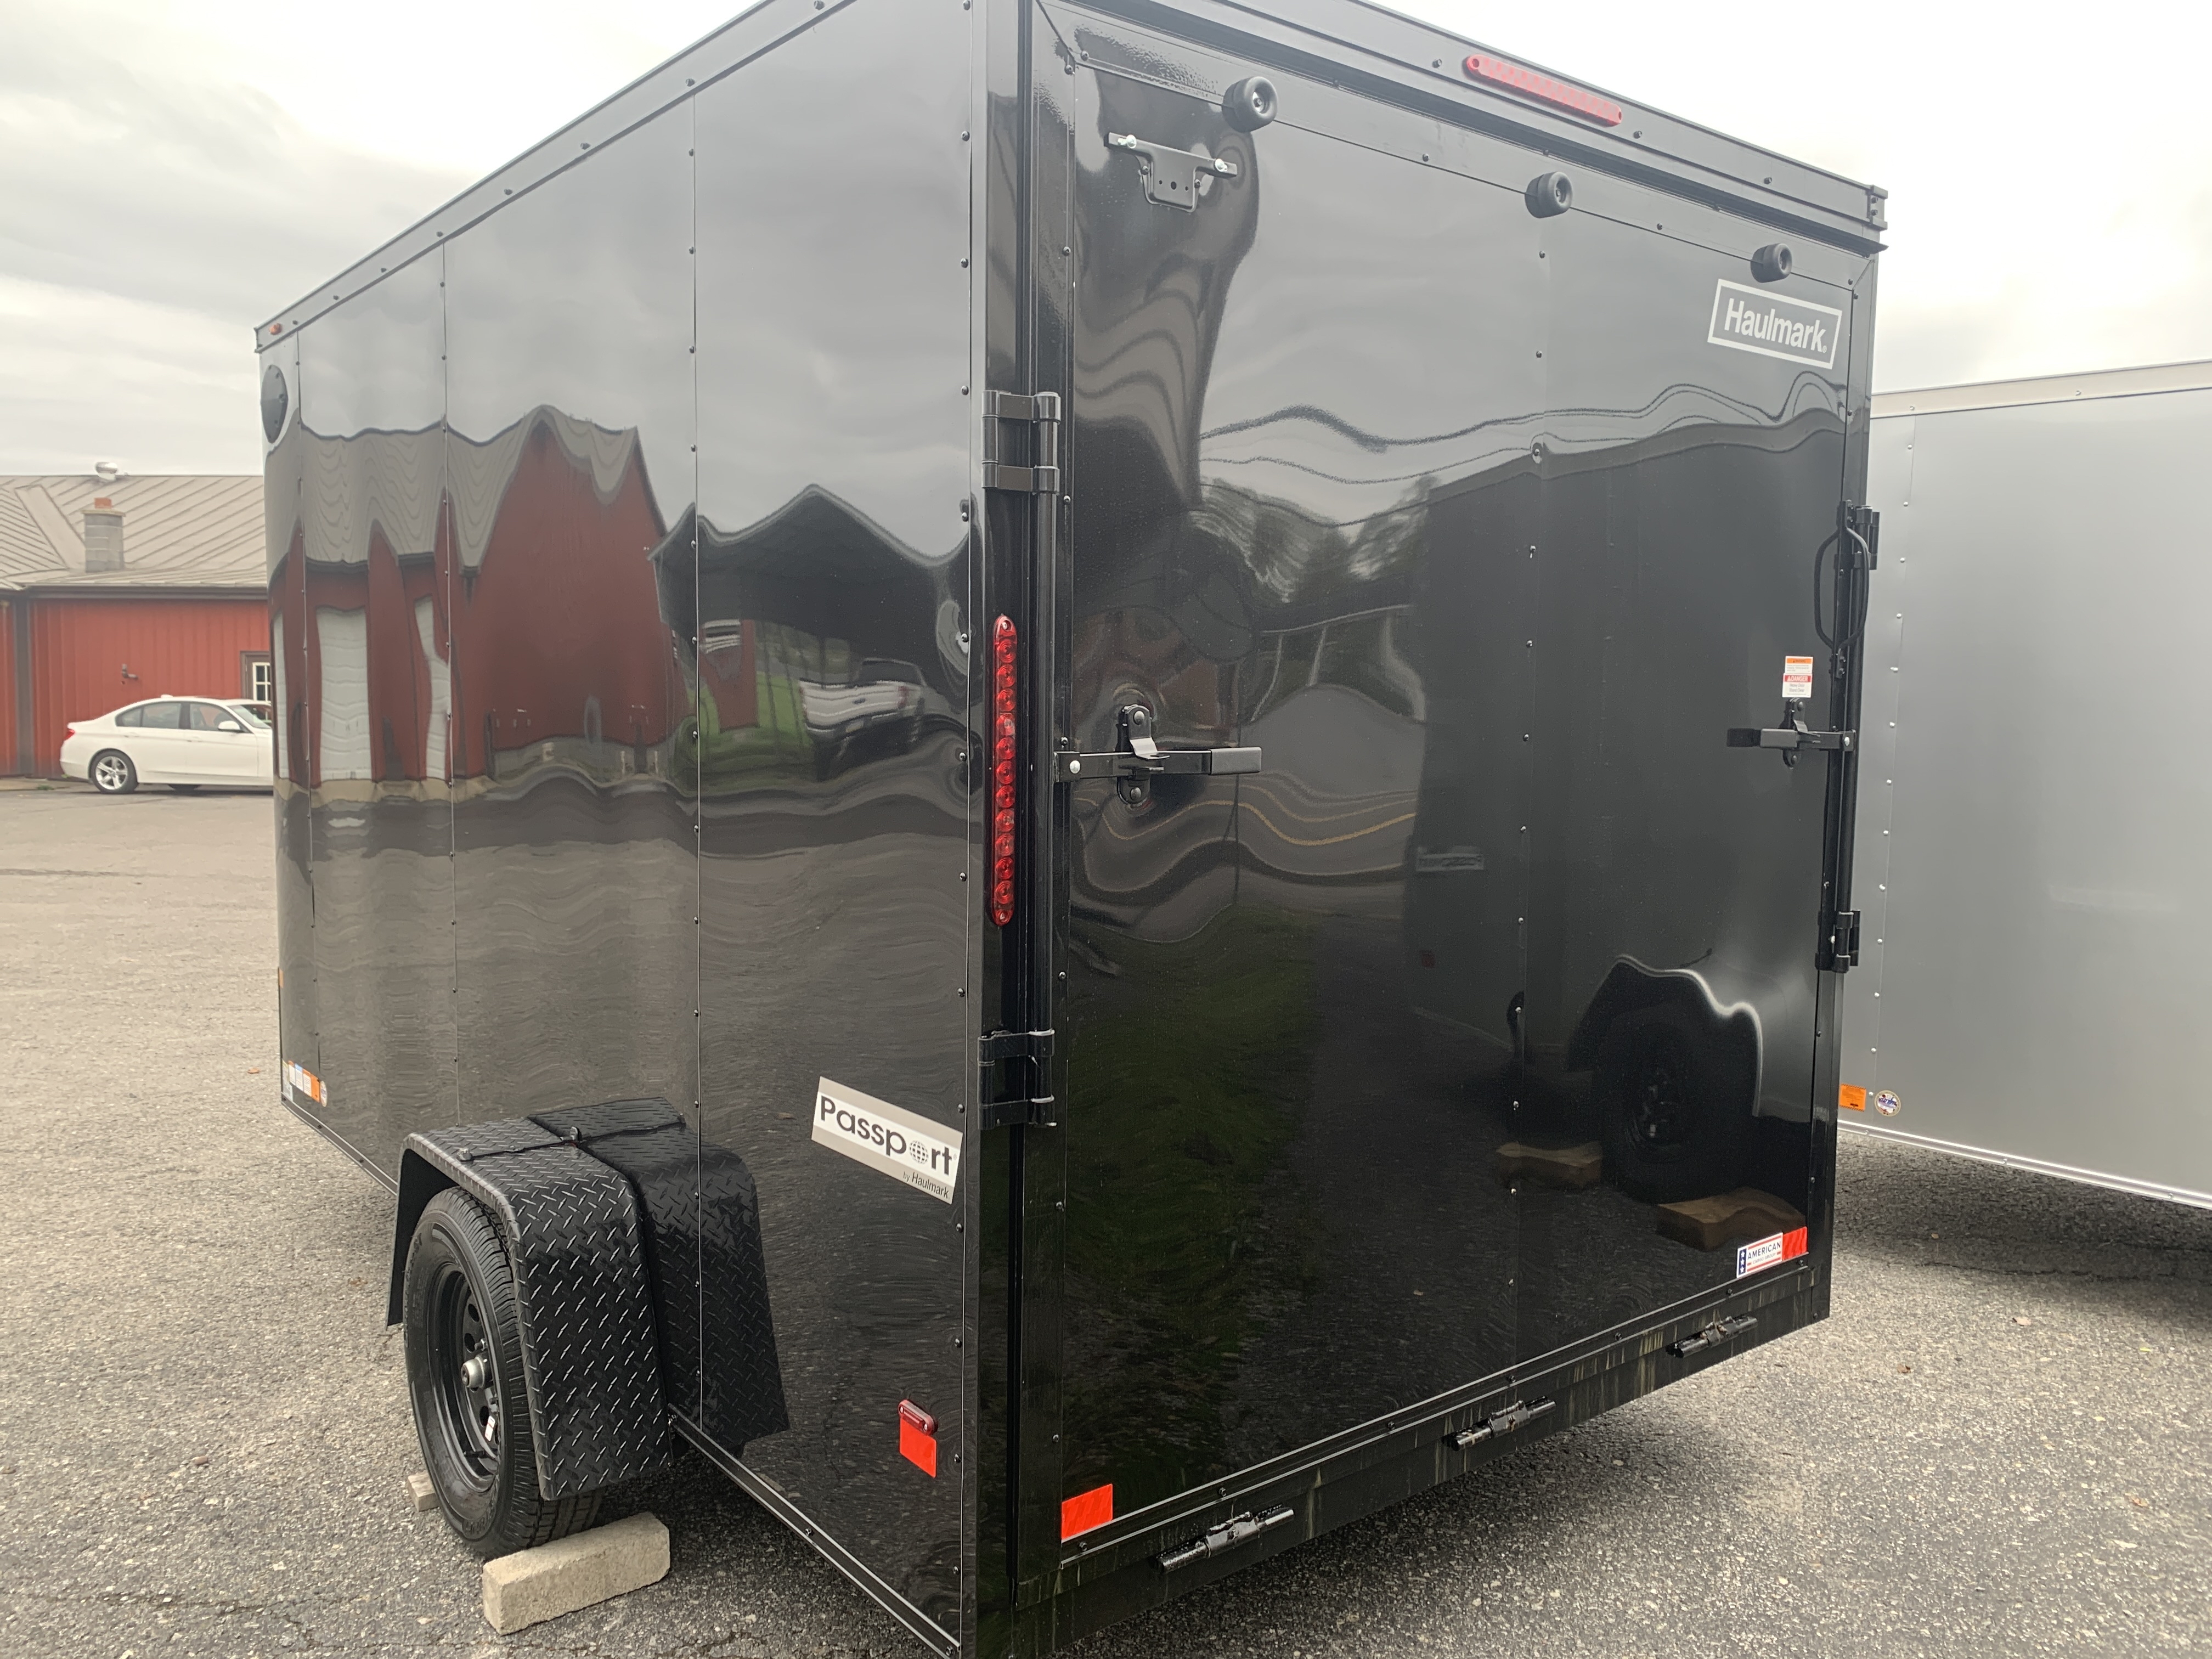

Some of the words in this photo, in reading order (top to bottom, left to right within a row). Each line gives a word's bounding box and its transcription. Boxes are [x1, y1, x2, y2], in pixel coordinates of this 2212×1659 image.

[1724, 298, 1826, 353] Haulmark
[903, 1171, 910, 1182] by
[911, 1172, 949, 1199] Haulmark
[1747, 1241, 1781, 1260] AMERICAN
[1752, 1256, 1764, 1265] CARGO
